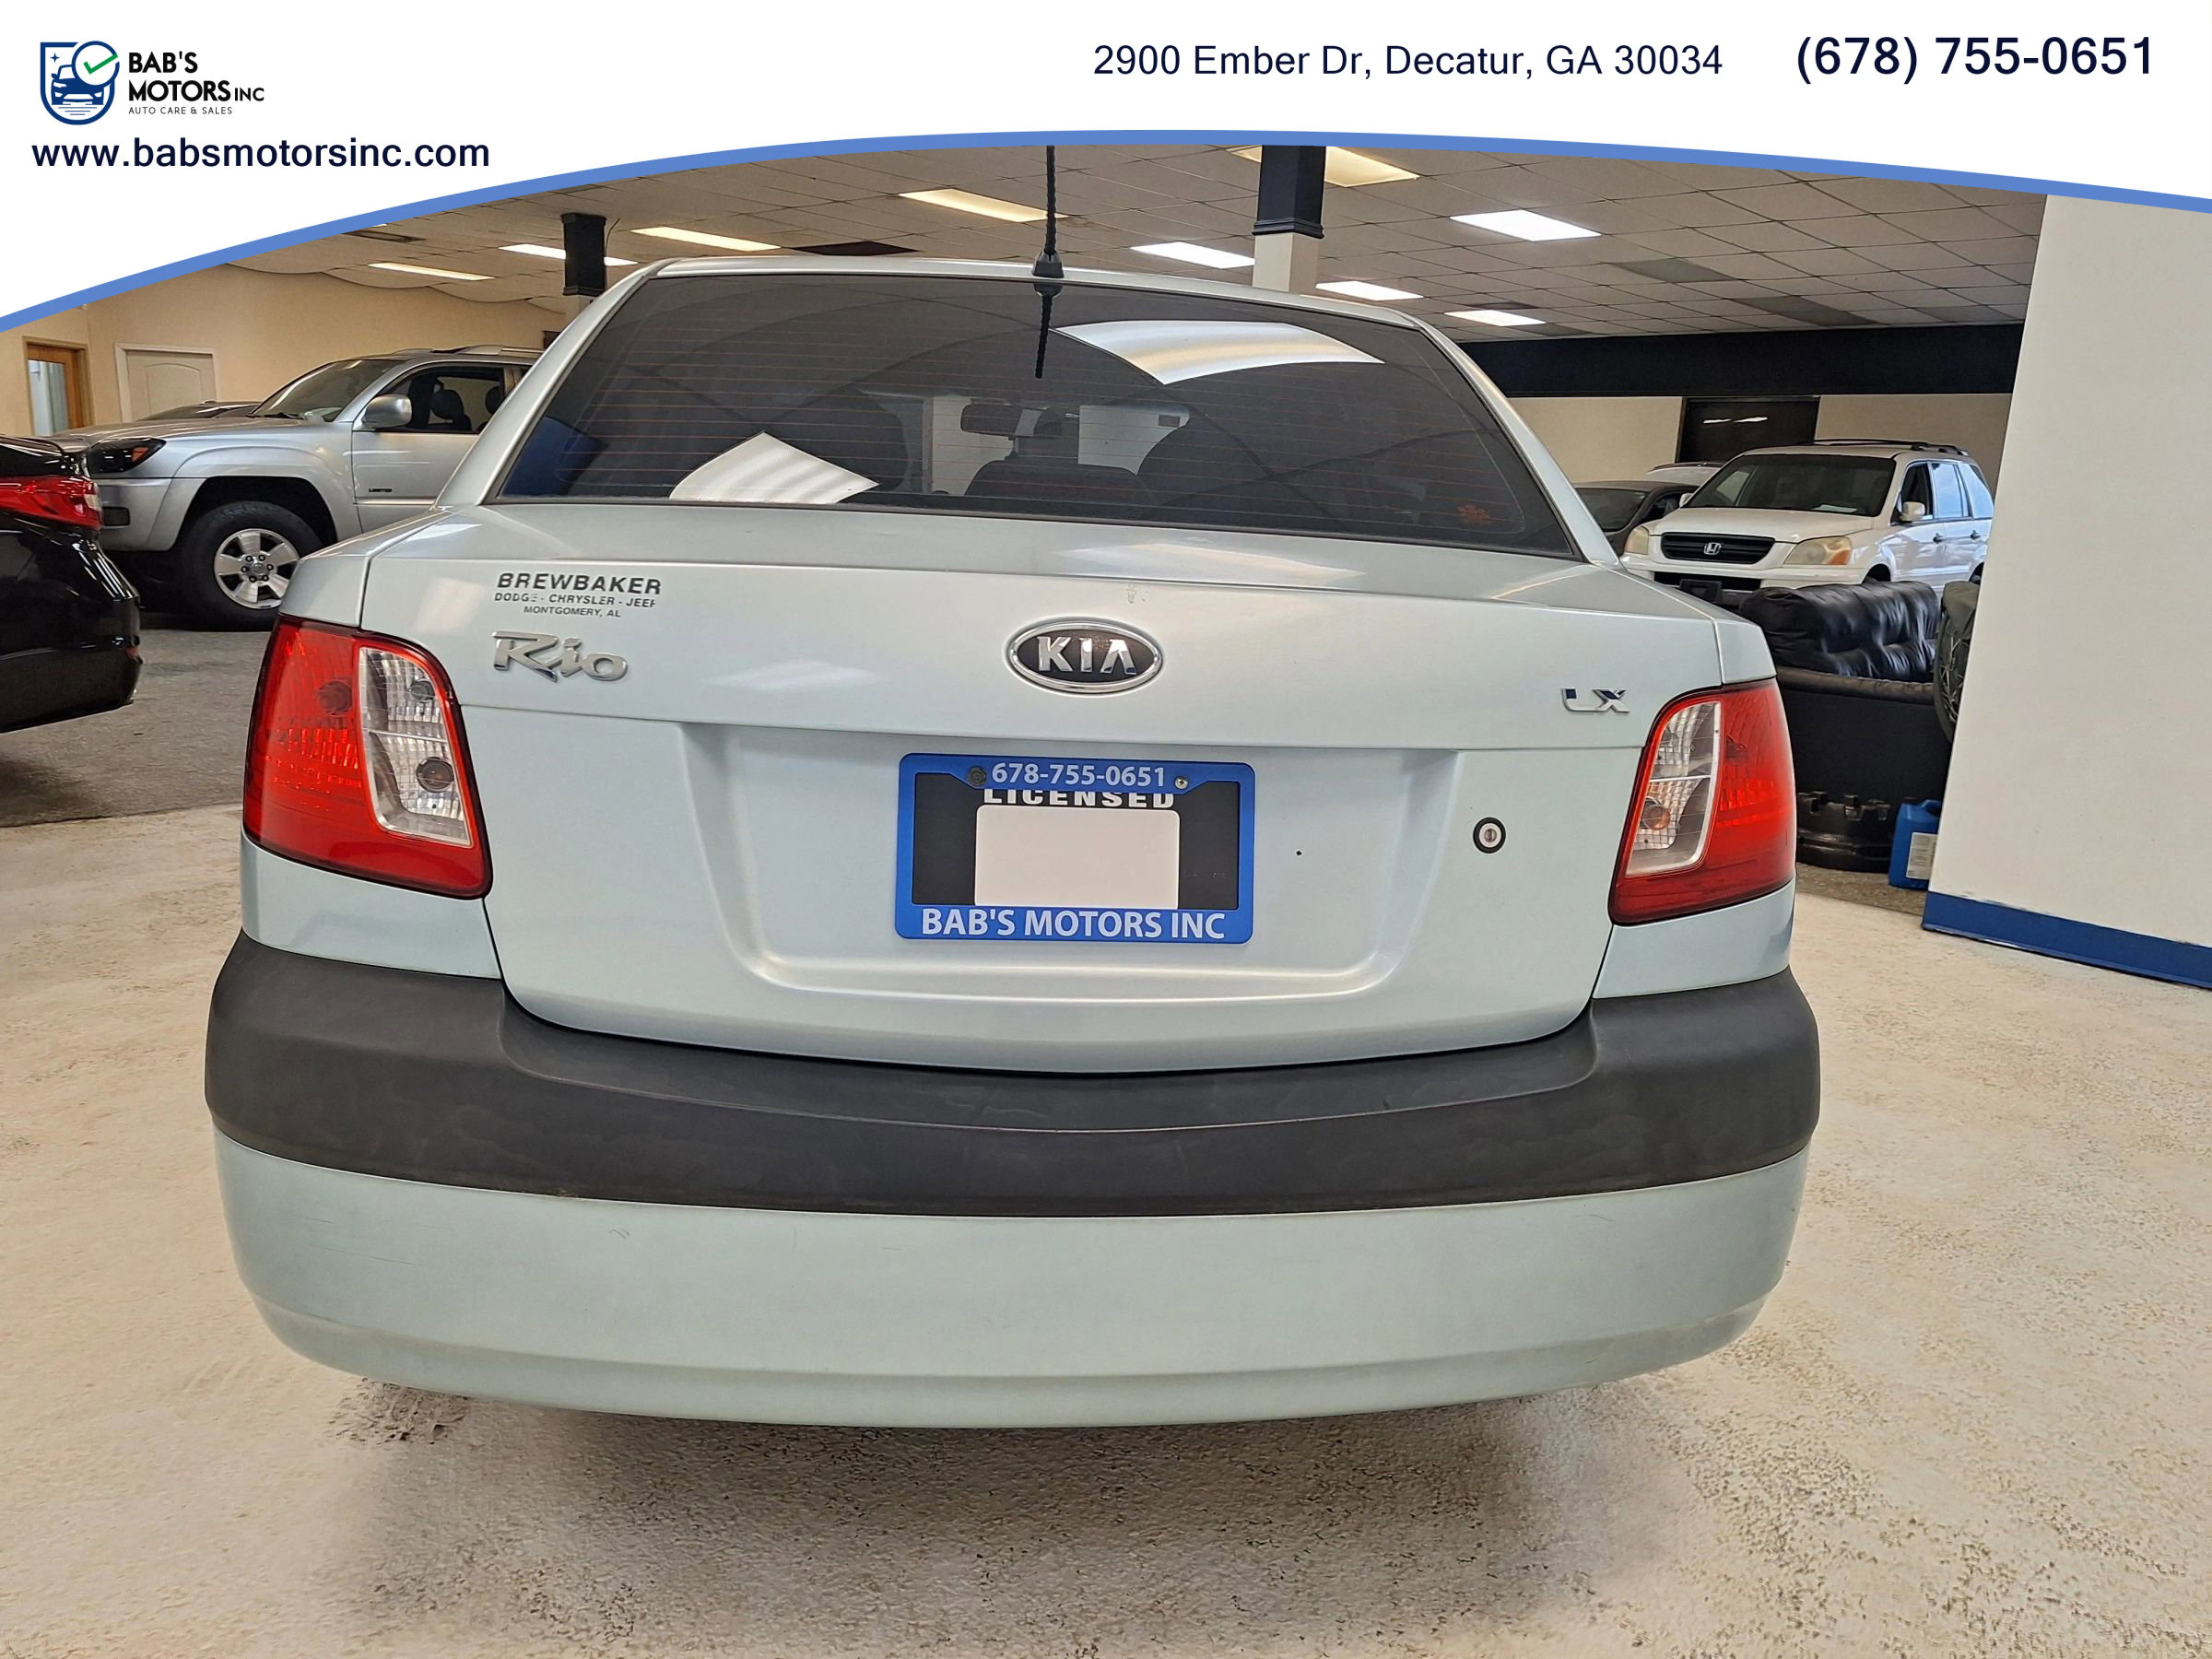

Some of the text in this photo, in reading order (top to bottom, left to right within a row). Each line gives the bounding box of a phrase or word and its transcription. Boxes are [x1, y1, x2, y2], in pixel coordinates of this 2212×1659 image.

[497, 572, 662, 595] BREWBAKER
[524, 605, 621, 618] MONTGOMERY, AL
[548, 594, 615, 606] CHRYSLER
[491, 630, 629, 683] Rio
[1036, 636, 1136, 676] KIA
[1560, 688, 1630, 713] LX
[992, 762, 1165, 787] 678-755-0651
[983, 788, 1175, 808] LICENSED
[922, 908, 1225, 939] BAB'S MOTORS INC
